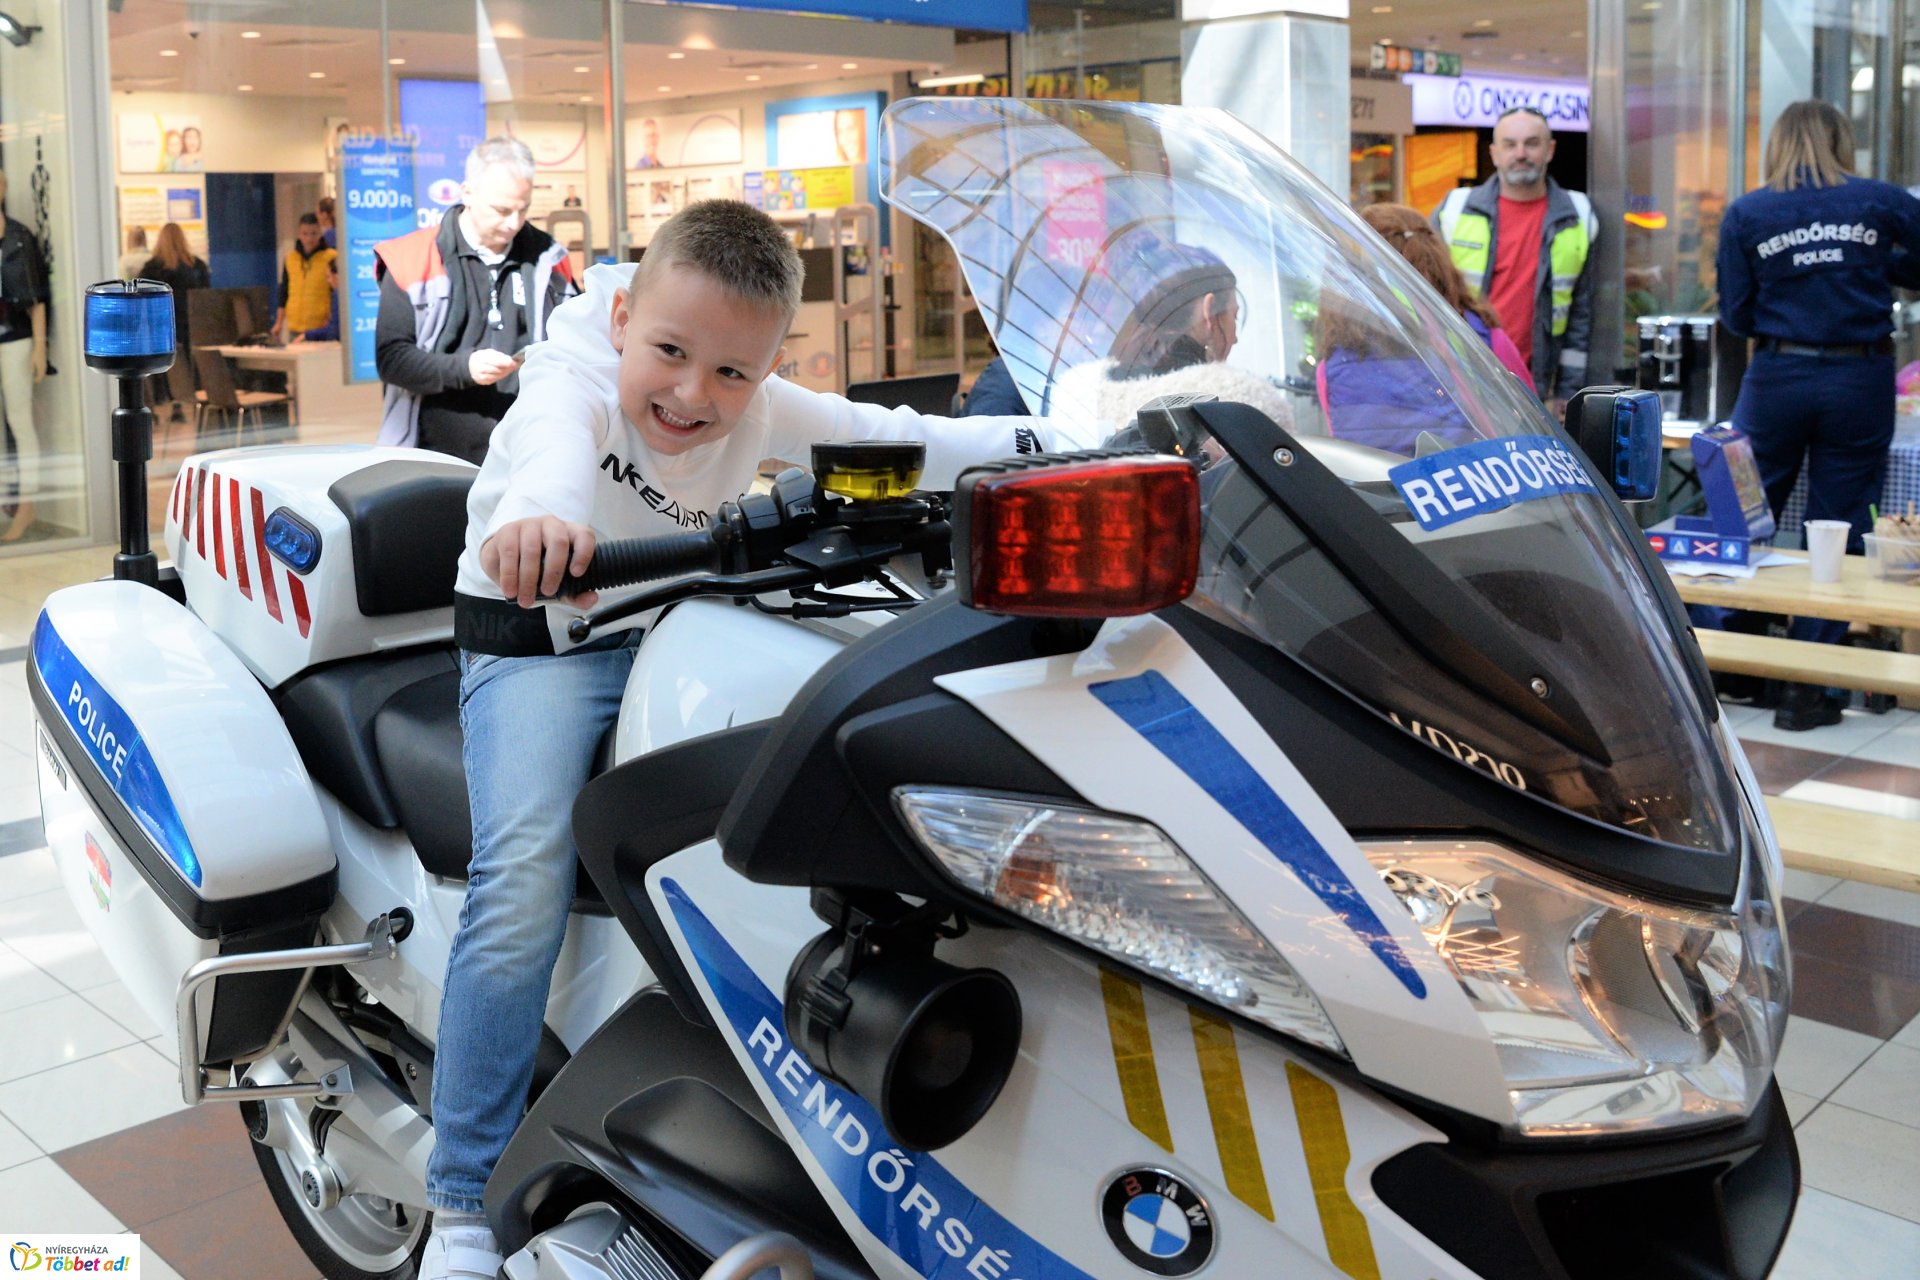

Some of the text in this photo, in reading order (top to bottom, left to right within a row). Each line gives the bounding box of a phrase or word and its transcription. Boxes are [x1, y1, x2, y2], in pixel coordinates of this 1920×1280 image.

[348, 188, 399, 209] 9.000
[1792, 248, 1844, 266] POLICE
[69, 680, 127, 779] POLICE
[748, 1016, 1024, 1280] RENDŐRSÉ
[1122, 1175, 1209, 1227] BMW
